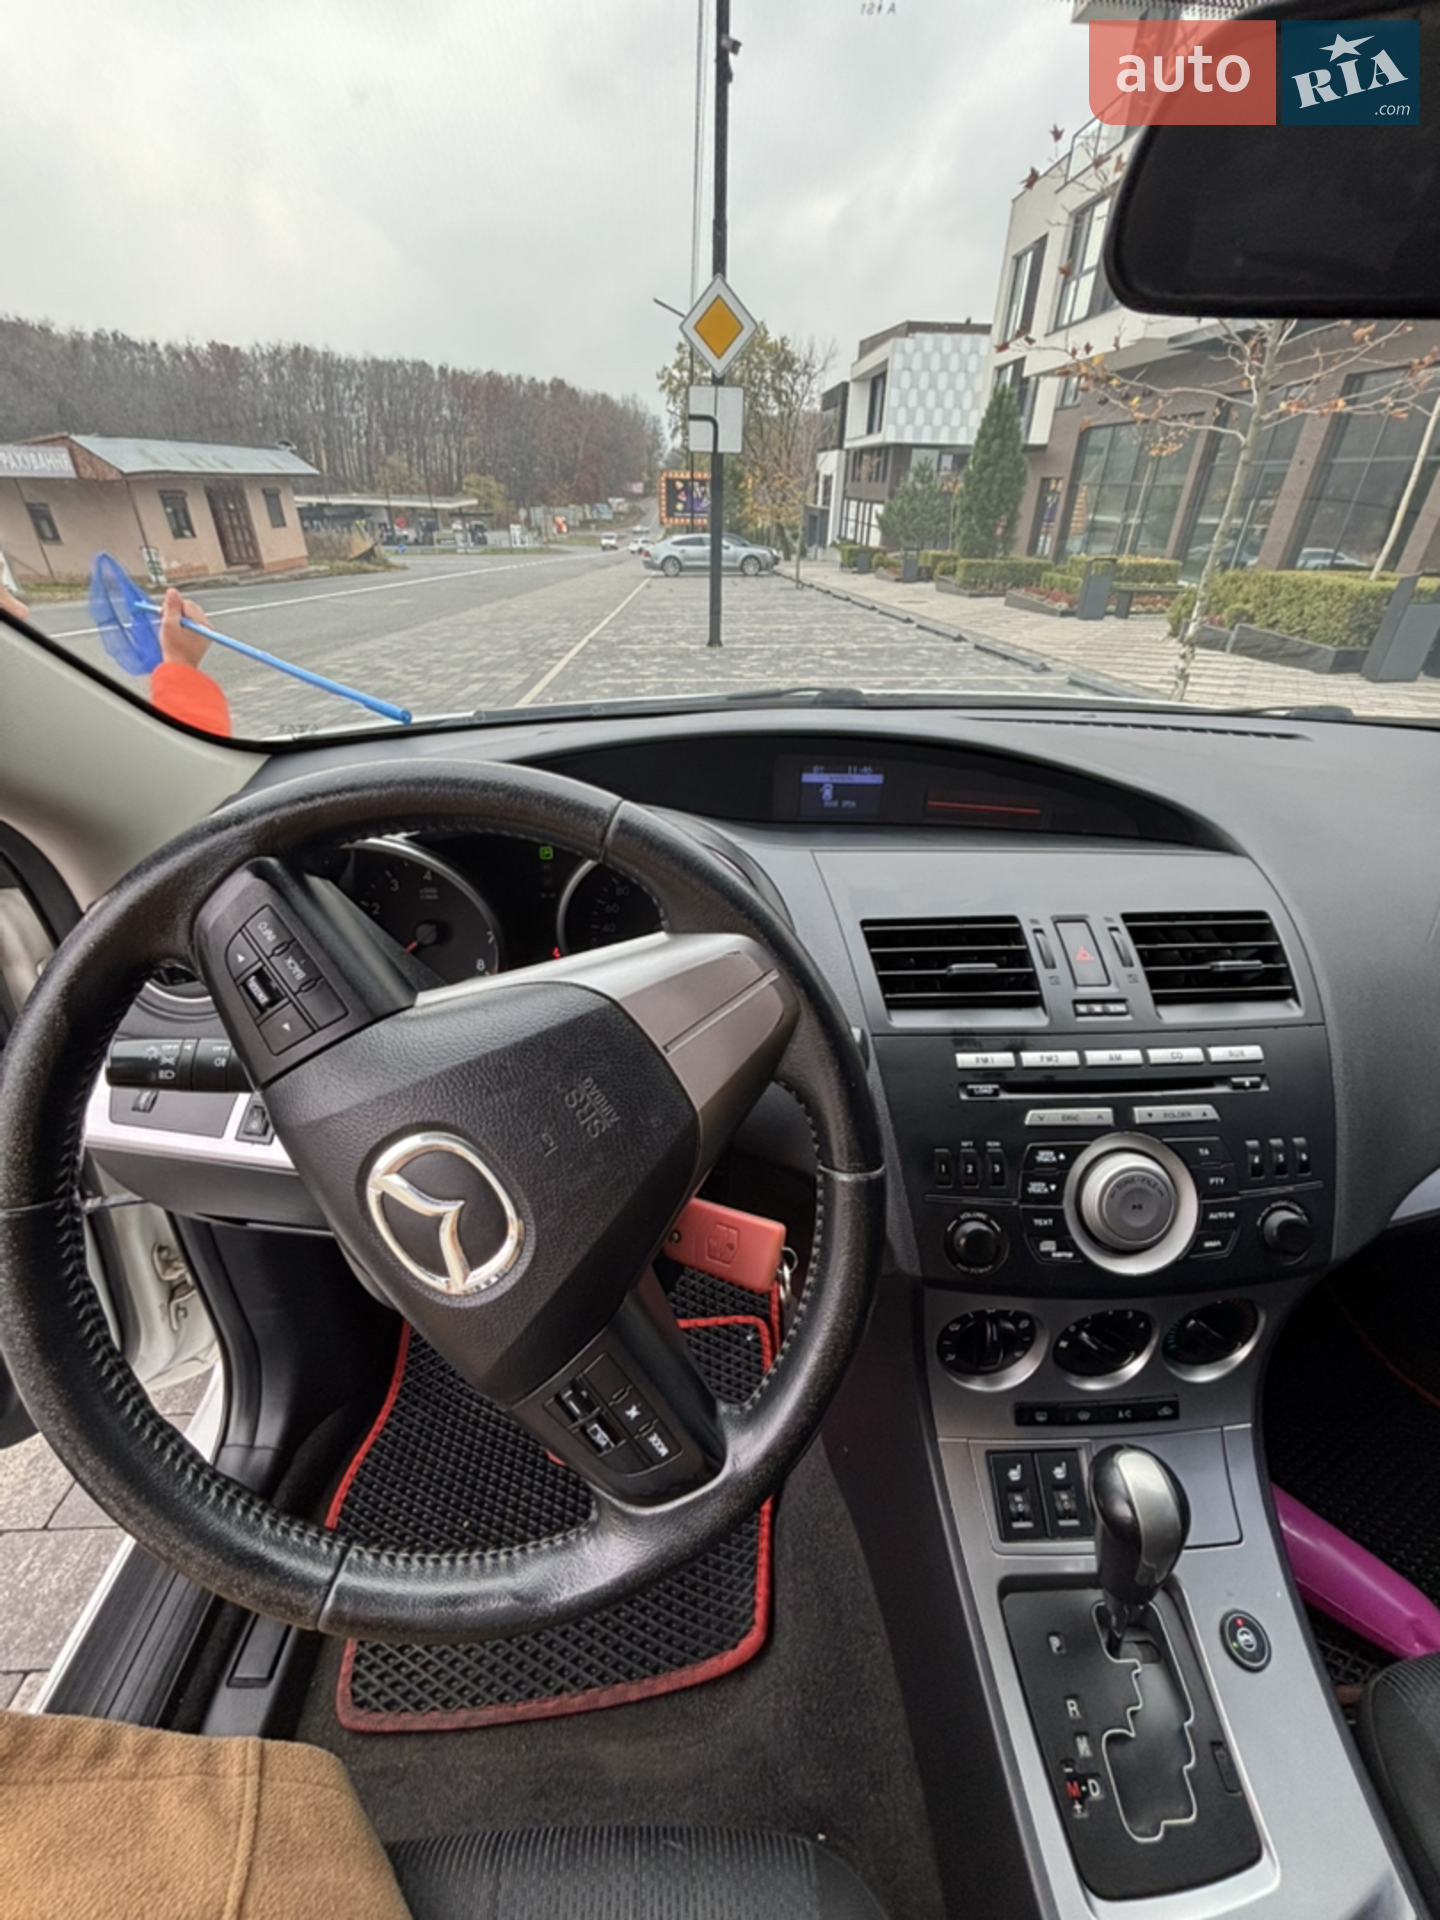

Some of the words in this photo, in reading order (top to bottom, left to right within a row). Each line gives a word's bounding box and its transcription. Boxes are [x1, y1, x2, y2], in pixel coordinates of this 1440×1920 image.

[423, 870, 432, 881] 4
[390, 880, 400, 892] 3
[371, 902, 381, 915] 2
[257, 921, 277, 942] INFO
[487, 931, 495, 944] 7
[285, 956, 307, 981] BACK
[476, 958, 486, 972] 8
[1109, 1053, 1122, 1061] AM
[564, 1089, 604, 1139] SRS
[1061, 1114, 1081, 1122] DISC
[1163, 1111, 1192, 1119] FOLDER
[1199, 1148, 1210, 1156] TA
[1209, 1177, 1225, 1185] PTY
[960, 1212, 988, 1220] VOLUME
[647, 1432, 670, 1458] MODE
[1049, 1636, 1062, 1653] P
[1066, 1699, 1081, 1719] R
[1066, 1780, 1081, 1798] M
[1087, 1778, 1100, 1798] D
